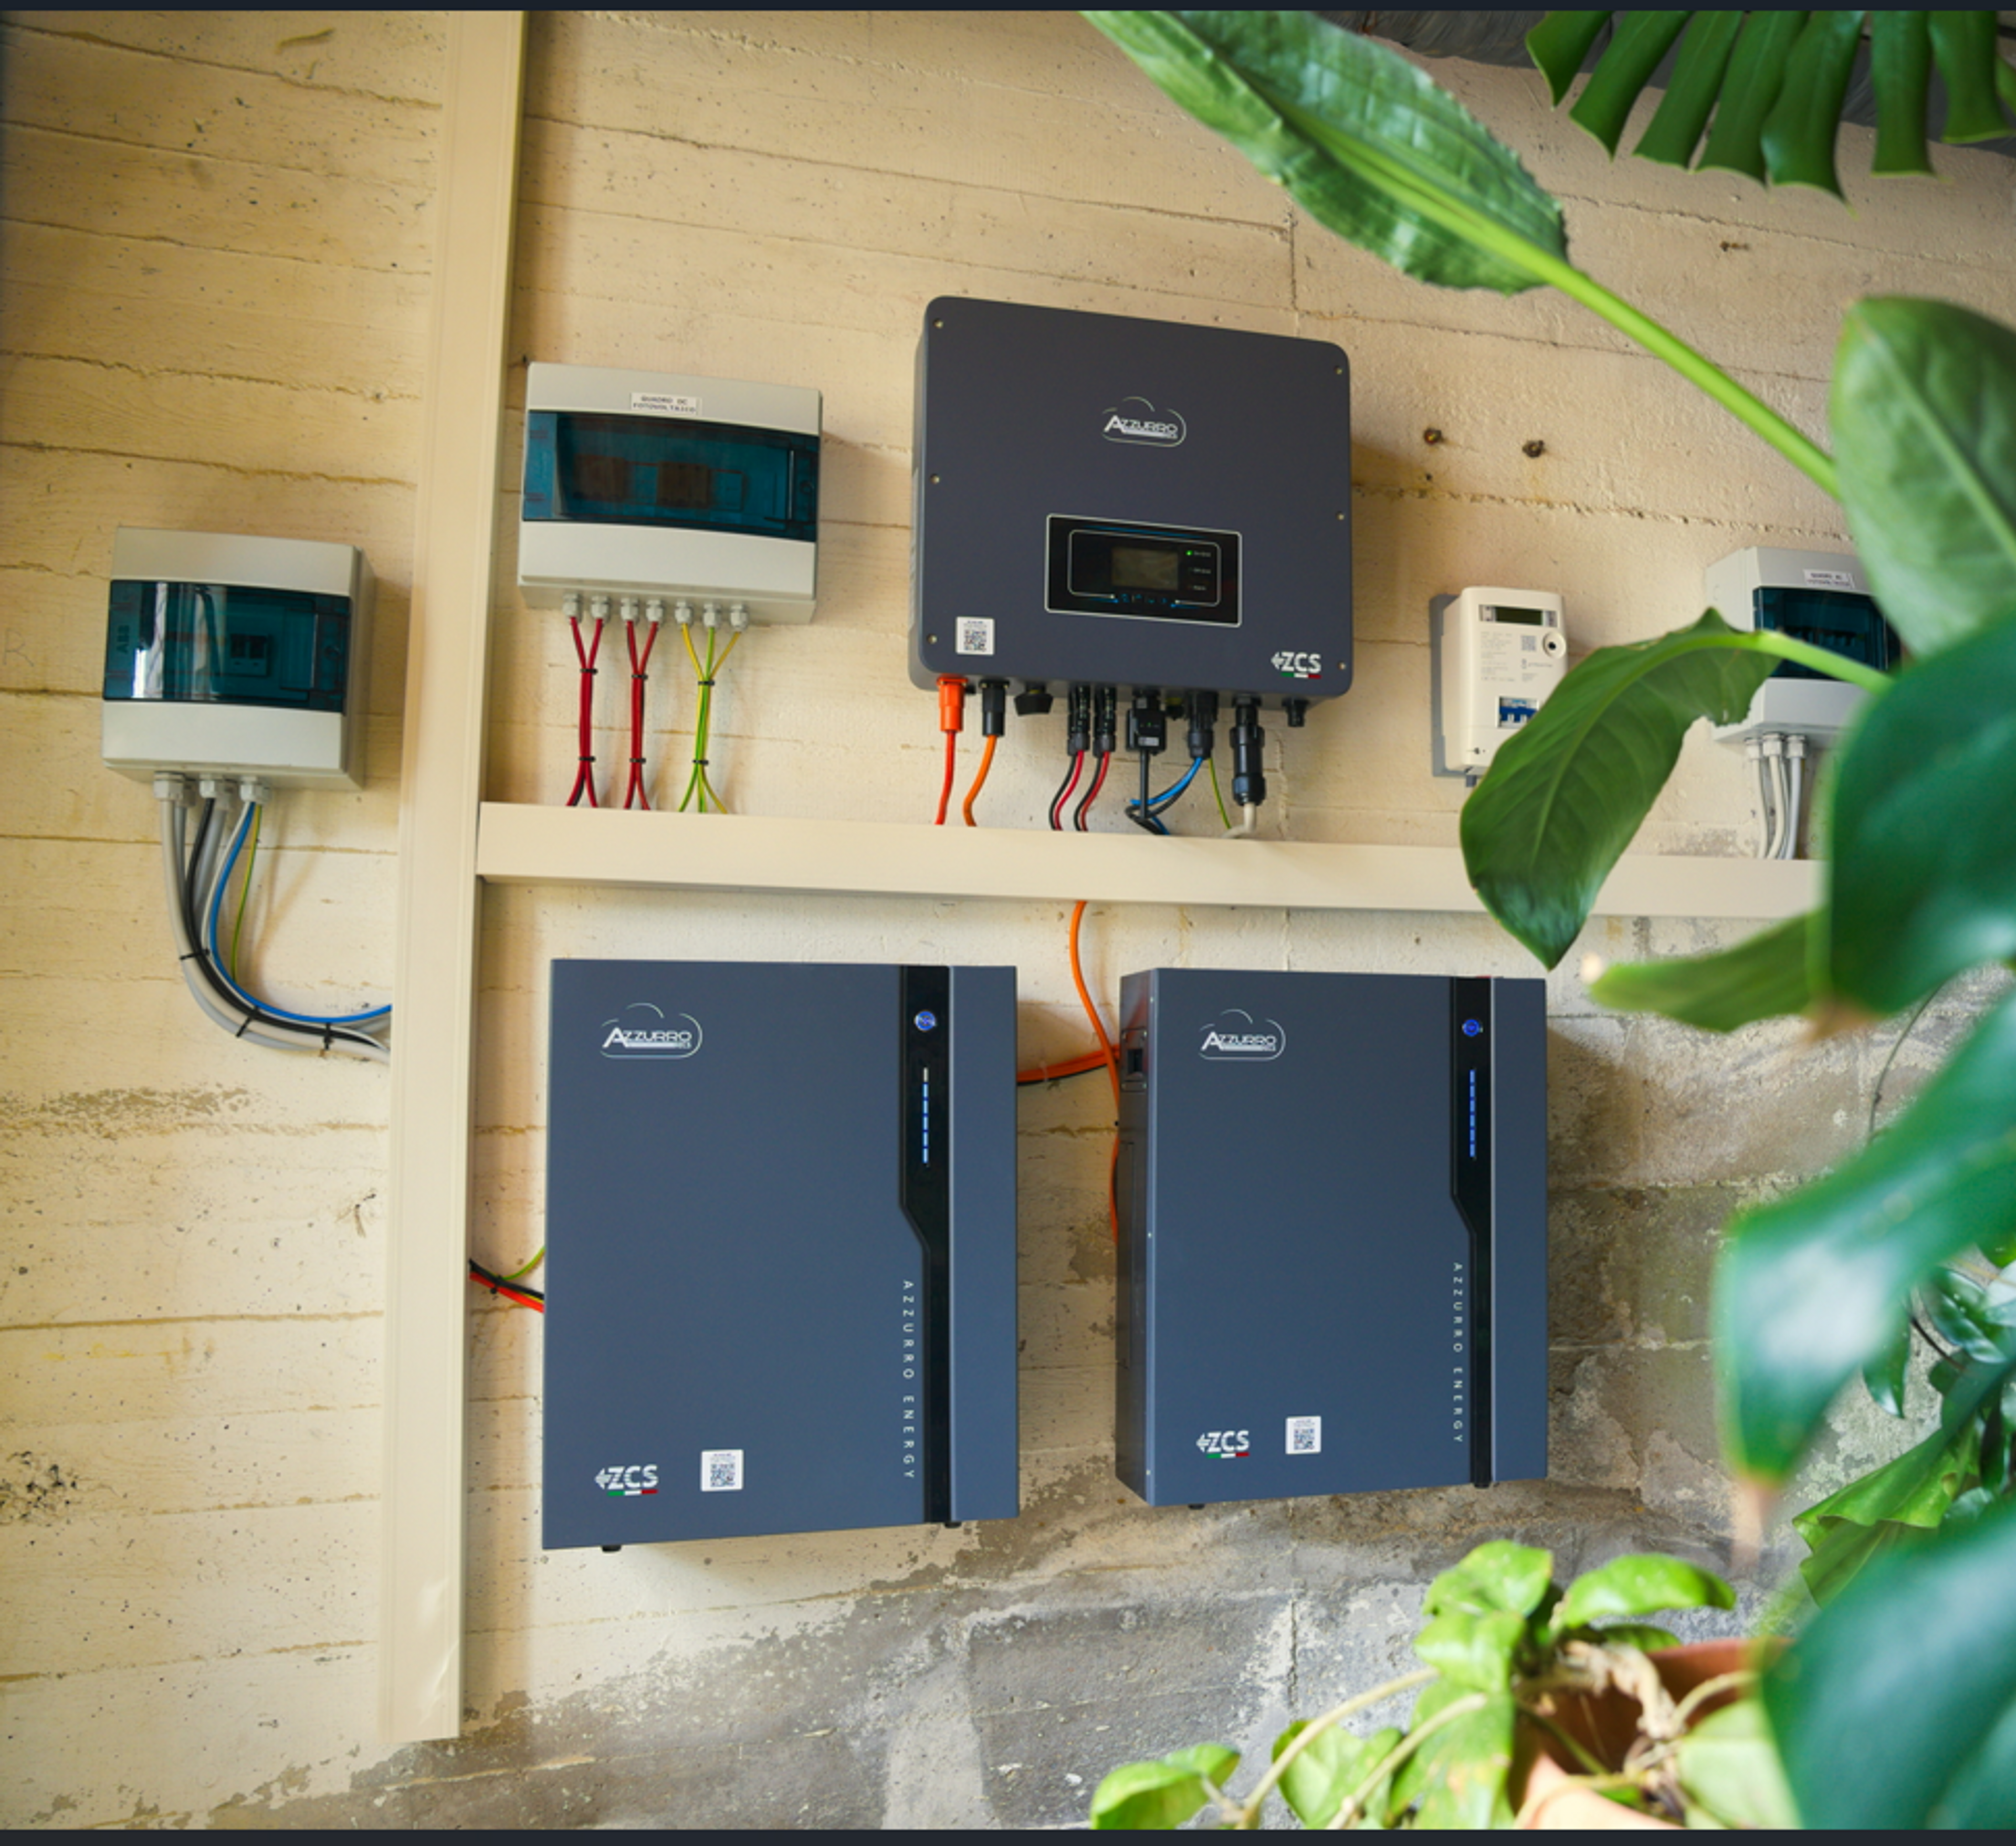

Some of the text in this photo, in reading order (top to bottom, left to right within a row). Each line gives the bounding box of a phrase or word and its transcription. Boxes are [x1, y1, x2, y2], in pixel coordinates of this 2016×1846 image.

[1104, 415, 1178, 438] AZZURRO
[1281, 652, 1321, 673] ZCS
[602, 1027, 692, 1048] AZZURRO
[1201, 1031, 1276, 1051] AZZURRO
[1453, 1262, 1463, 1442] AZZURRO ENERGY
[902, 1280, 915, 1478] AZZURRO ENERGY
[1207, 1430, 1250, 1453] ZCS
[607, 1464, 659, 1490] ZCS
